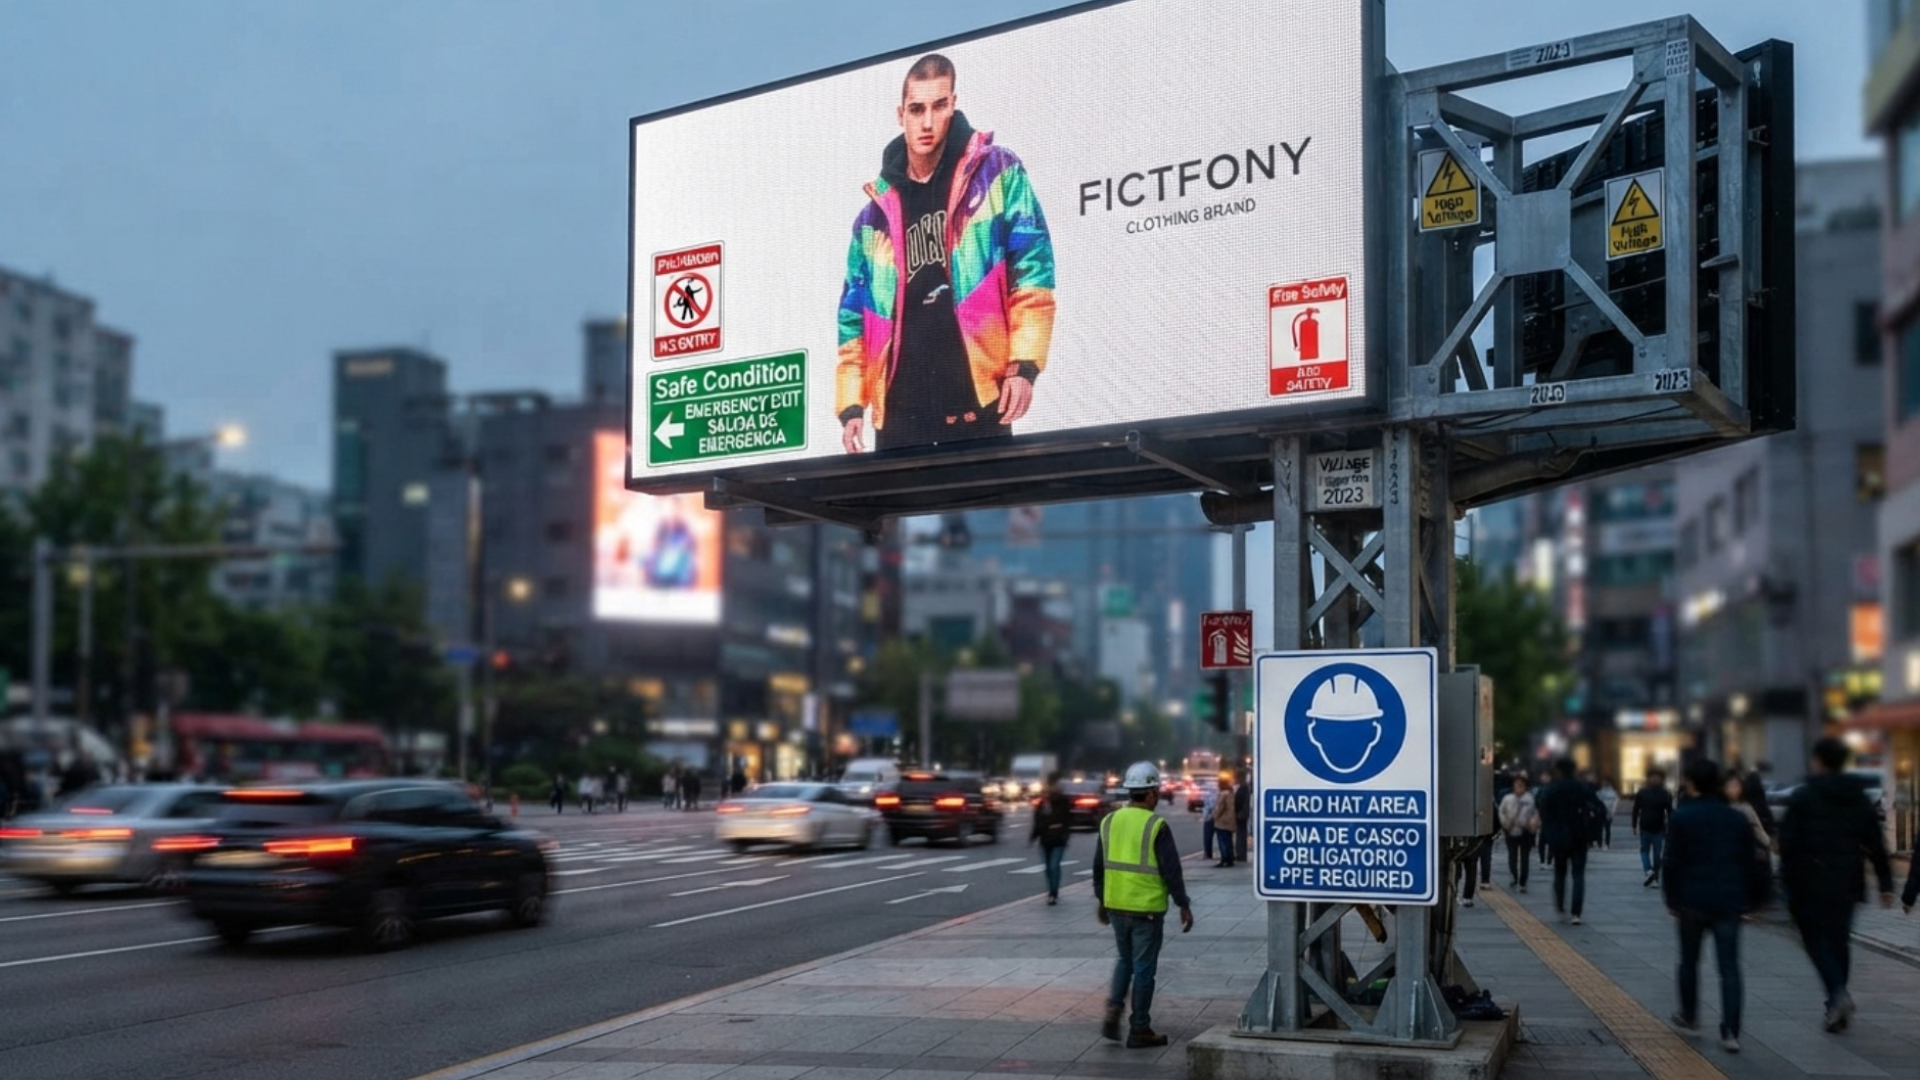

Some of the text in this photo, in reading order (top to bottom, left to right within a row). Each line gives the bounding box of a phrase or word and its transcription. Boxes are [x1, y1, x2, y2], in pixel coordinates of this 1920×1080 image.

[1080, 136, 1312, 216] FICTFONY
[1126, 197, 1256, 234] CLOTHING BRAND
[655, 362, 800, 399] Safe Condition
[1272, 795, 1419, 815] HARD HAT AREA
[1270, 826, 1420, 846] ZONA DE CASCO
[1283, 847, 1407, 867] OBLIGATORIO
[1279, 867, 1314, 885] PPE
[1319, 868, 1414, 889] REQUIRED
